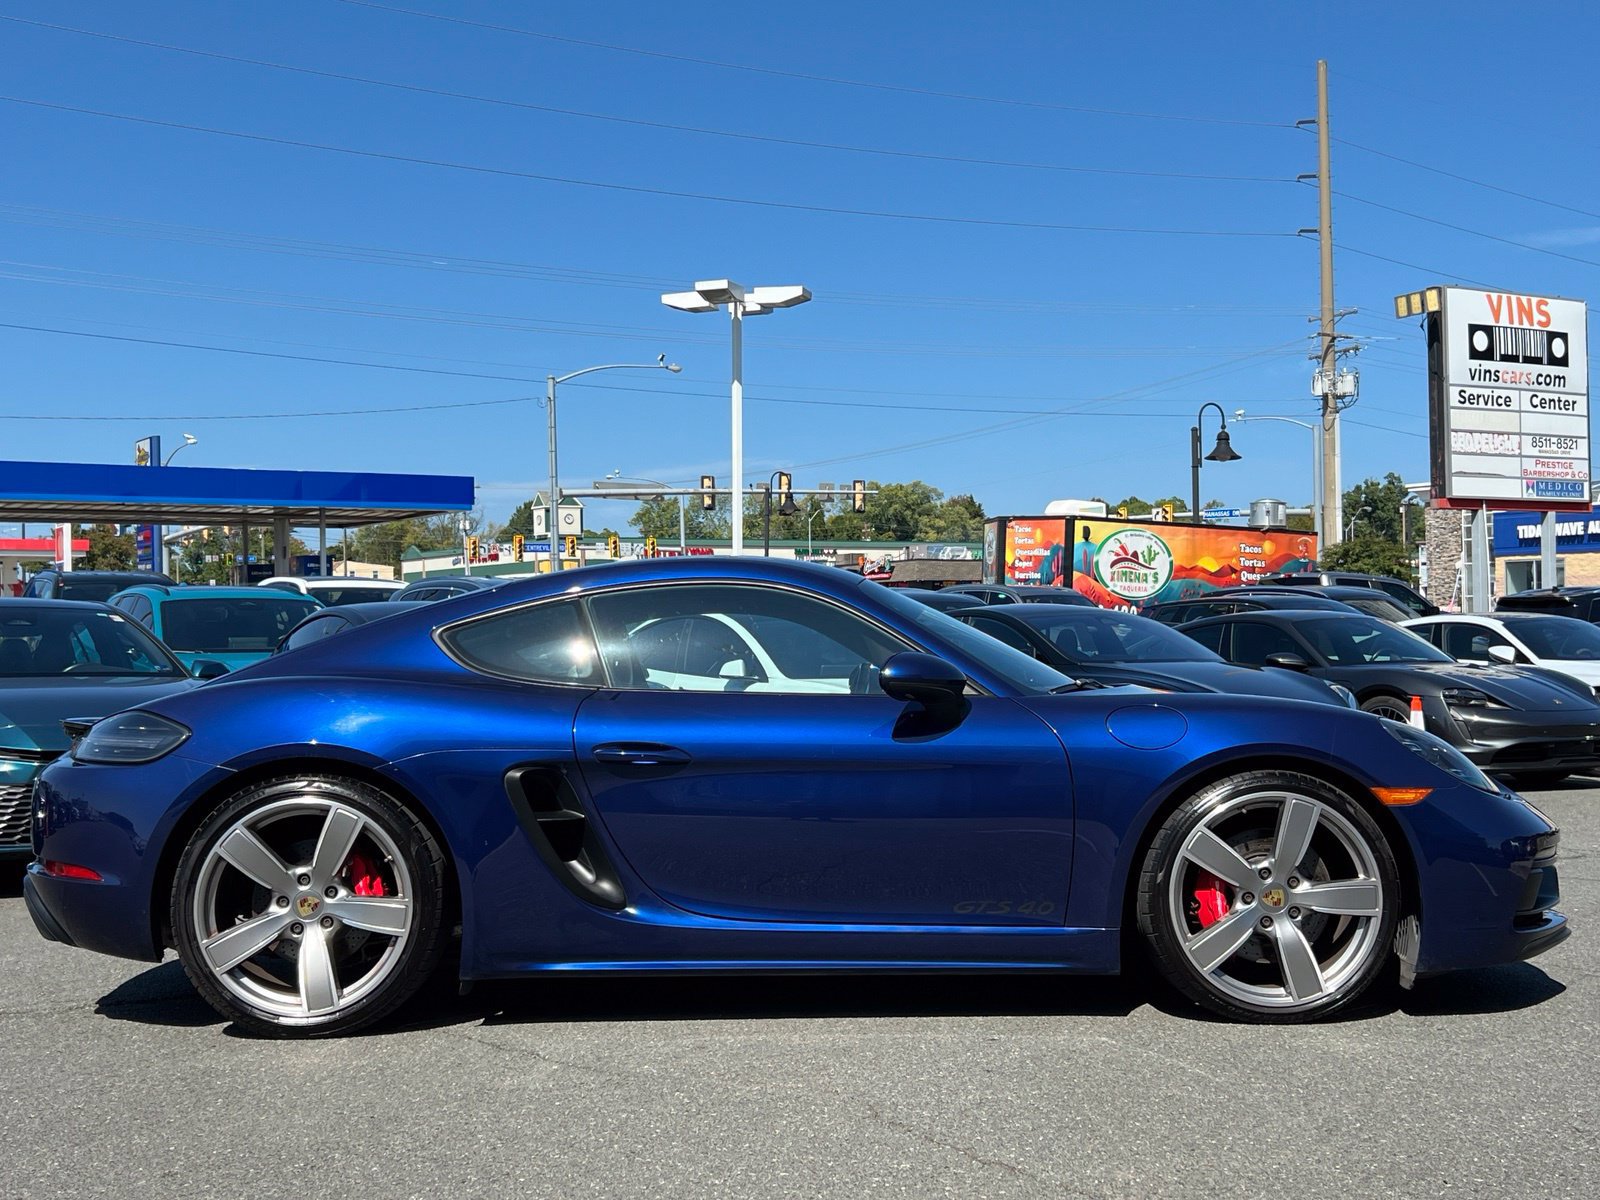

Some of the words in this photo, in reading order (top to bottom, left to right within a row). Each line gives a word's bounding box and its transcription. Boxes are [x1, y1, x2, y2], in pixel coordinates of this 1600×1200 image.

[1486, 294, 1551, 328] VINS
[1468, 364, 1566, 388] vinscars.com
[1458, 390, 1512, 407] Service
[1530, 394, 1577, 411] Center
[1531, 437, 1578, 450] 8511-8521
[1535, 460, 1574, 469] PRESTIGE
[1523, 469, 1569, 478] BARBERSHOP
[1538, 482, 1582, 491] MEDICO
[1014, 525, 1032, 533] Tacos
[1517, 525, 1542, 539] TIDA
[1555, 521, 1584, 536] WAVE
[1015, 548, 1051, 556] Quesadillas
[1240, 544, 1262, 554] Tacos
[1014, 560, 1033, 568] Sopes
[1240, 557, 1266, 568] Tortas
[1014, 571, 1041, 579] Burritos
[1110, 570, 1159, 584] XIMENA'S
[1119, 585, 1148, 593] TAQUERIA
[953, 901, 1013, 914] GTS
[1017, 901, 1054, 915] 4.0
